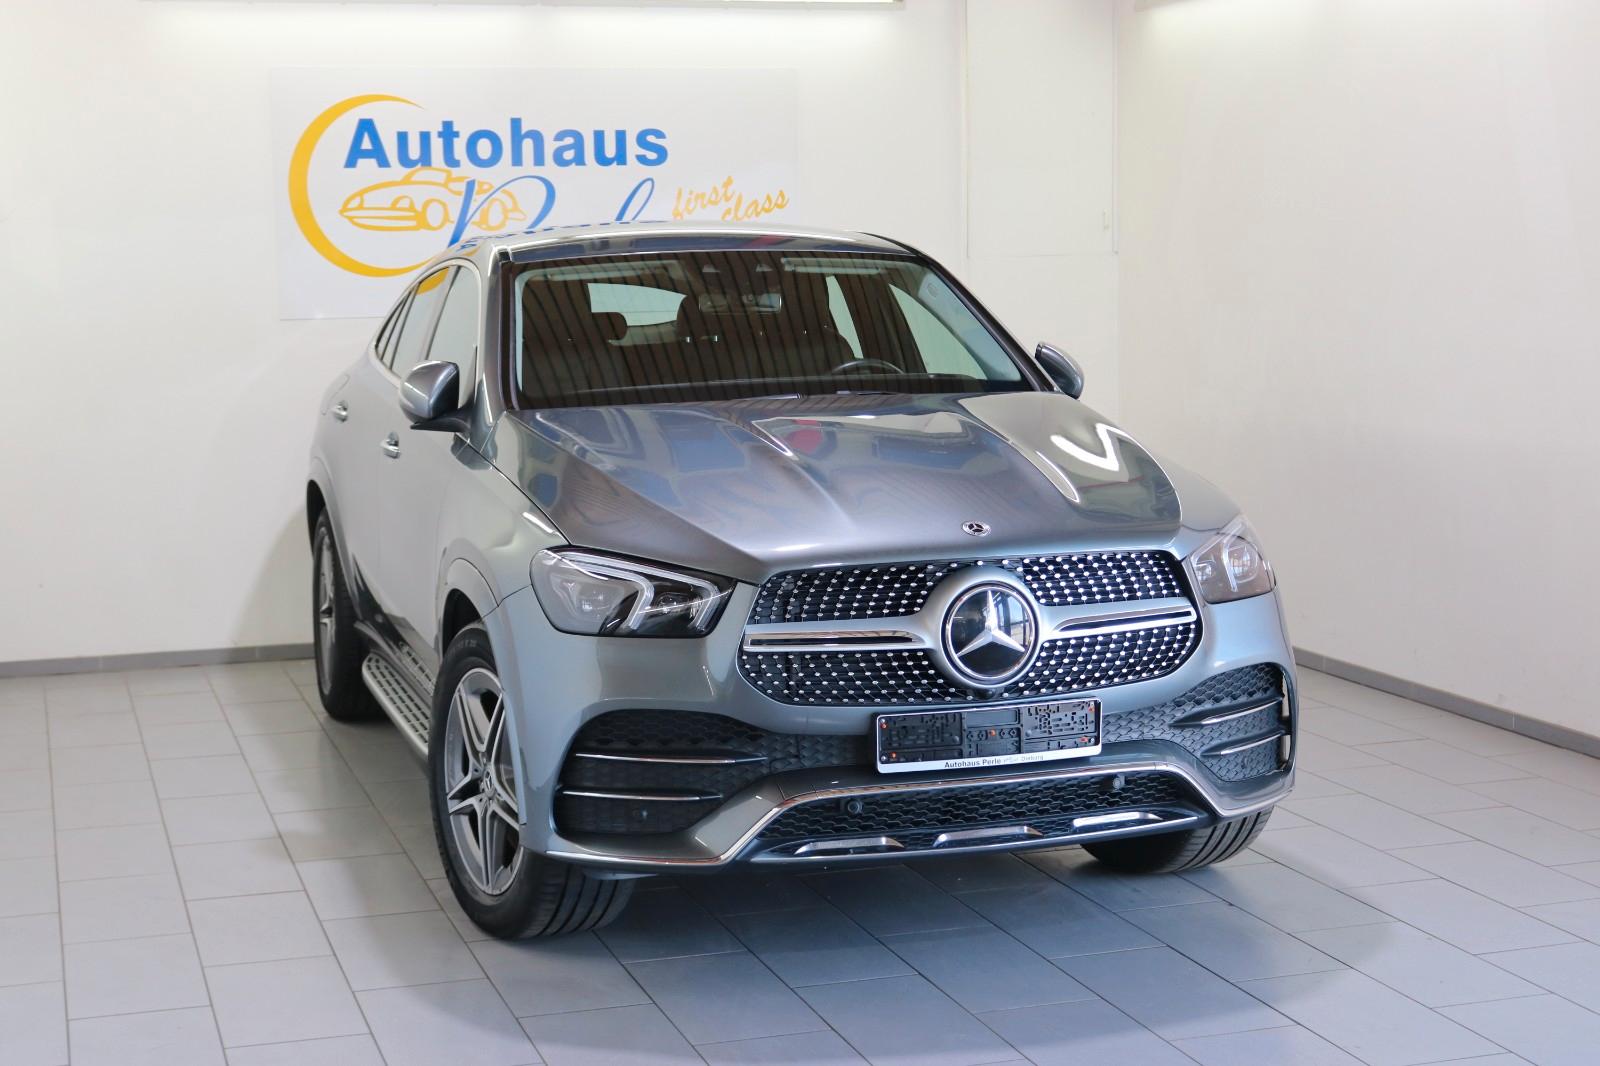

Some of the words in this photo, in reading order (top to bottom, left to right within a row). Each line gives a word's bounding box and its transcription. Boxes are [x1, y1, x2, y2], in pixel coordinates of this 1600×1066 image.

[344, 117, 669, 169] Autohaus
[672, 175, 734, 220] first
[721, 190, 789, 221] class
[944, 760, 980, 768] Autohaus
[982, 757, 1001, 766] Perle
